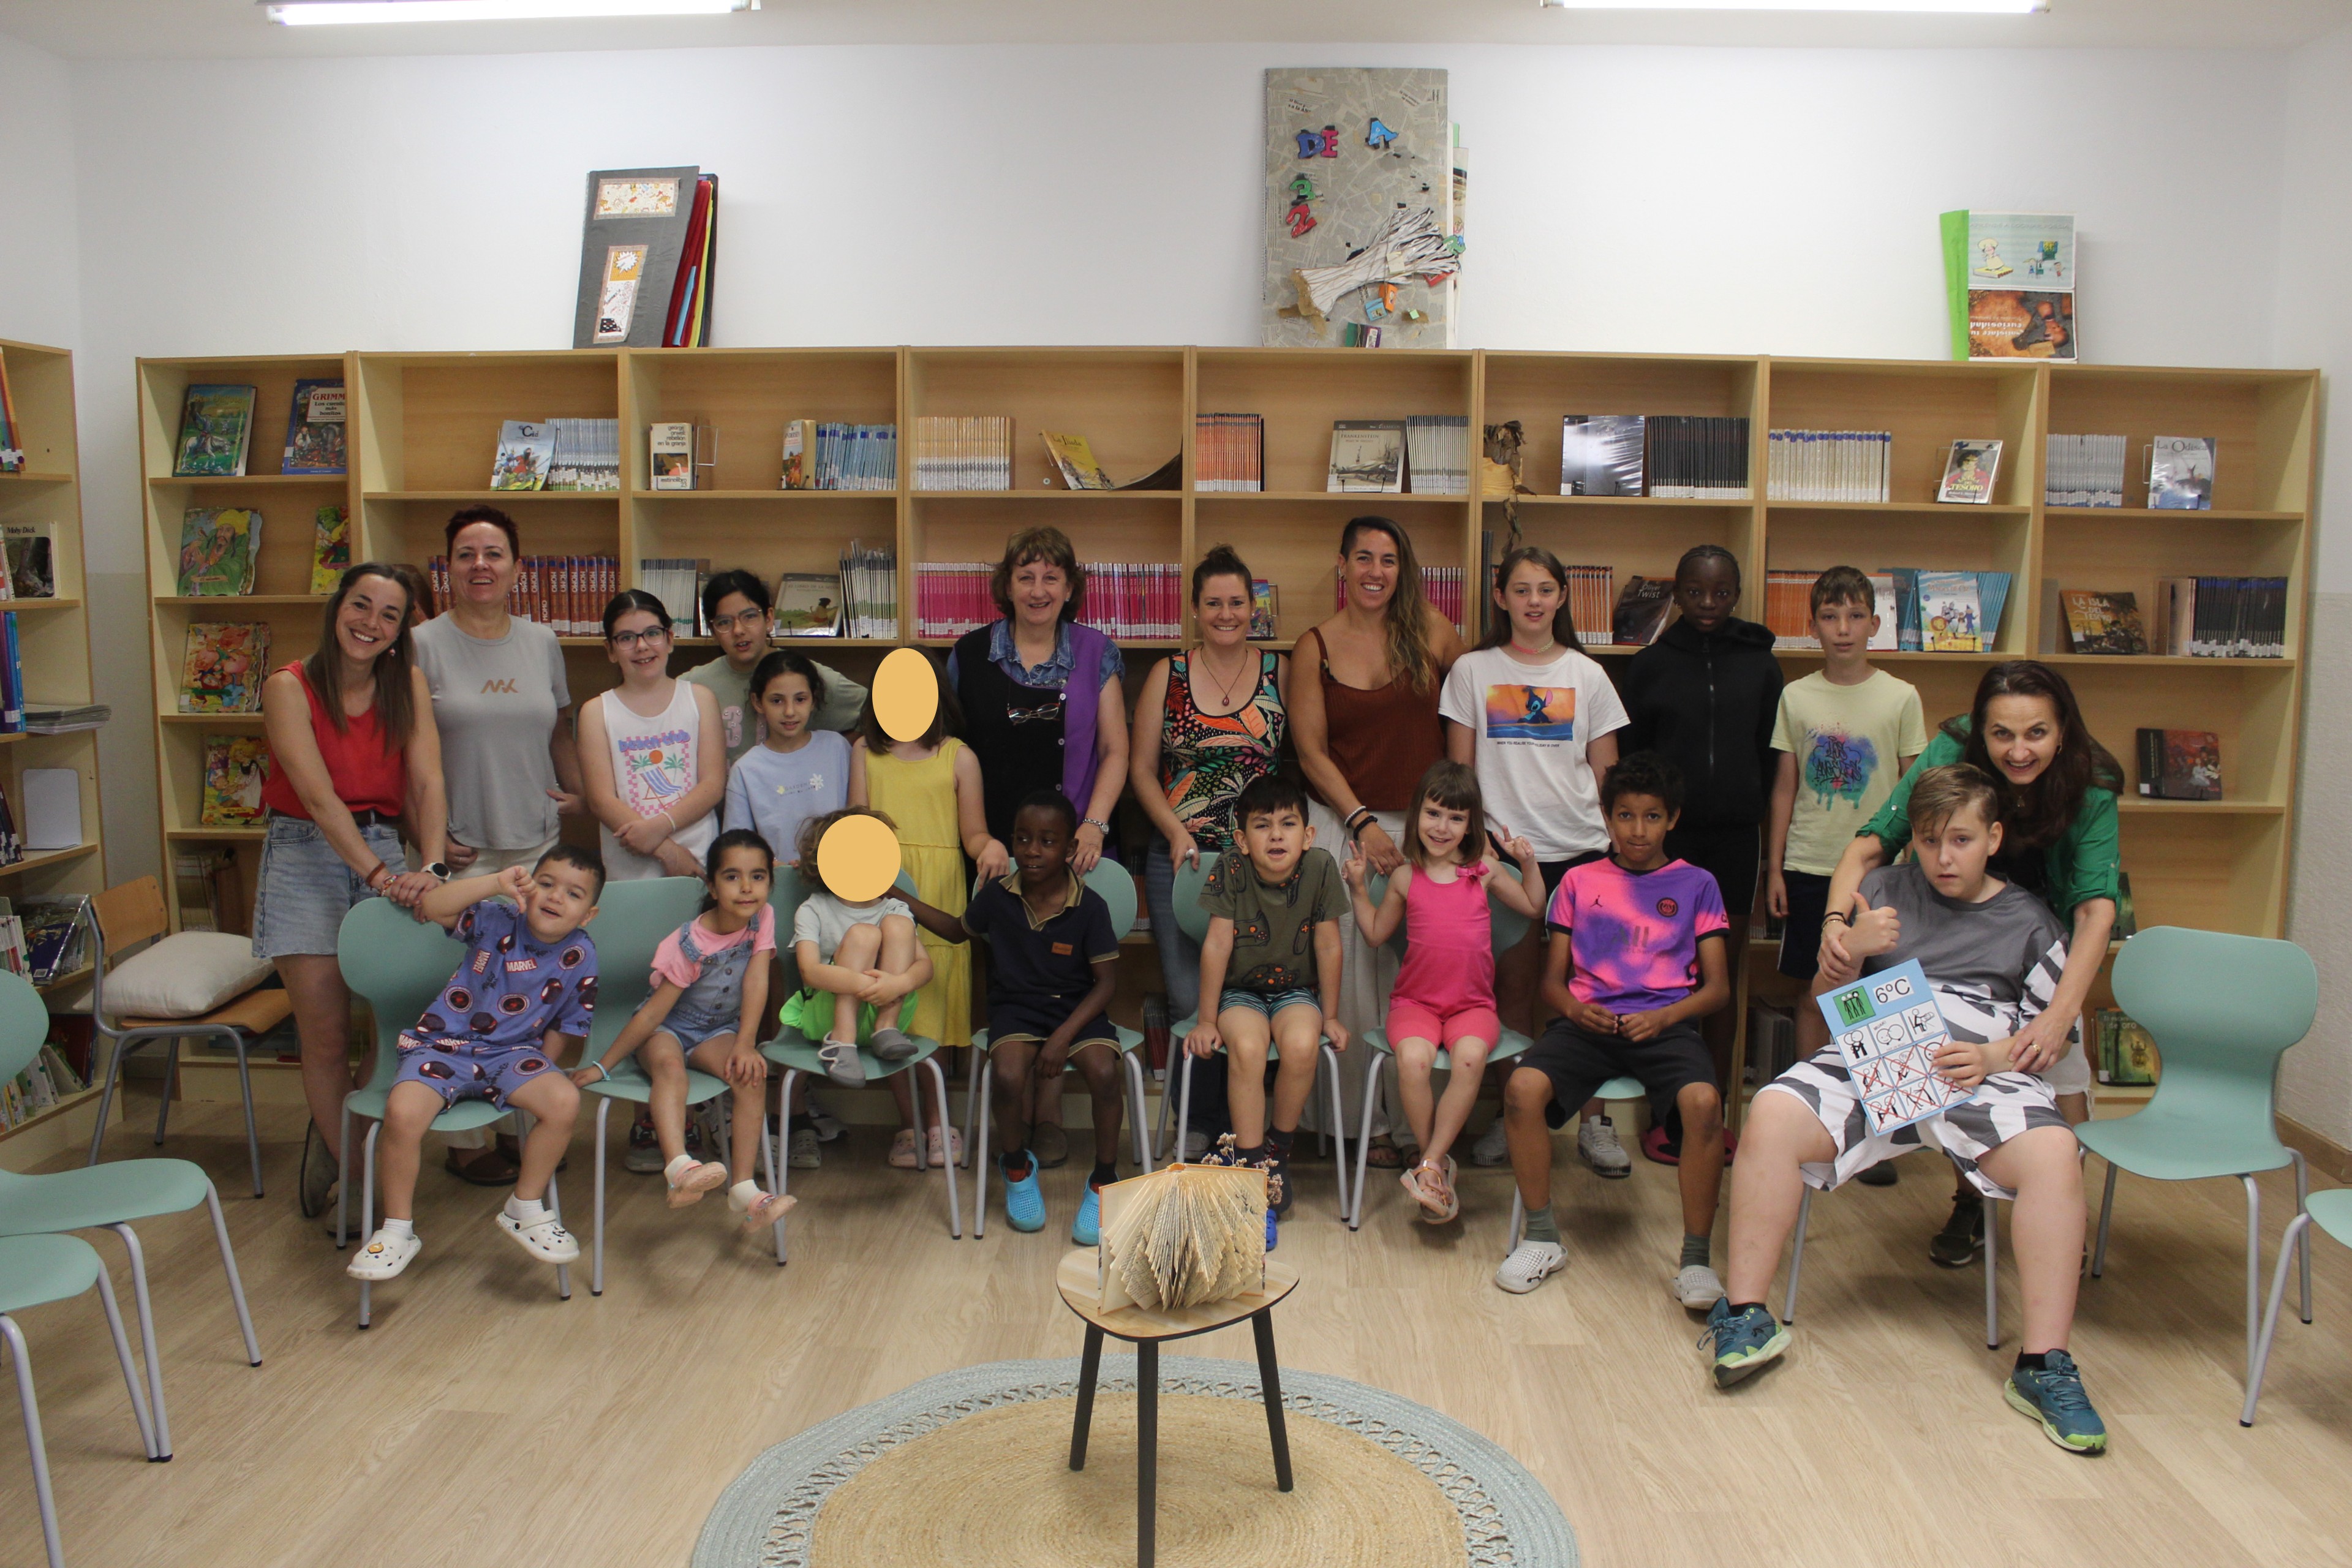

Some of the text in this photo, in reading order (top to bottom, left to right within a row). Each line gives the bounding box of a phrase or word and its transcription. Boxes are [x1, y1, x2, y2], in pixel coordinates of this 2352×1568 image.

[522, 426, 539, 437] Cid
[2157, 440, 2208, 453] La Odisea
[1638, 589, 1660, 598] Twist
[2088, 597, 2110, 607] ISLA
[473, 949, 491, 974] MARVEL
[507, 959, 537, 972] MARVEL
